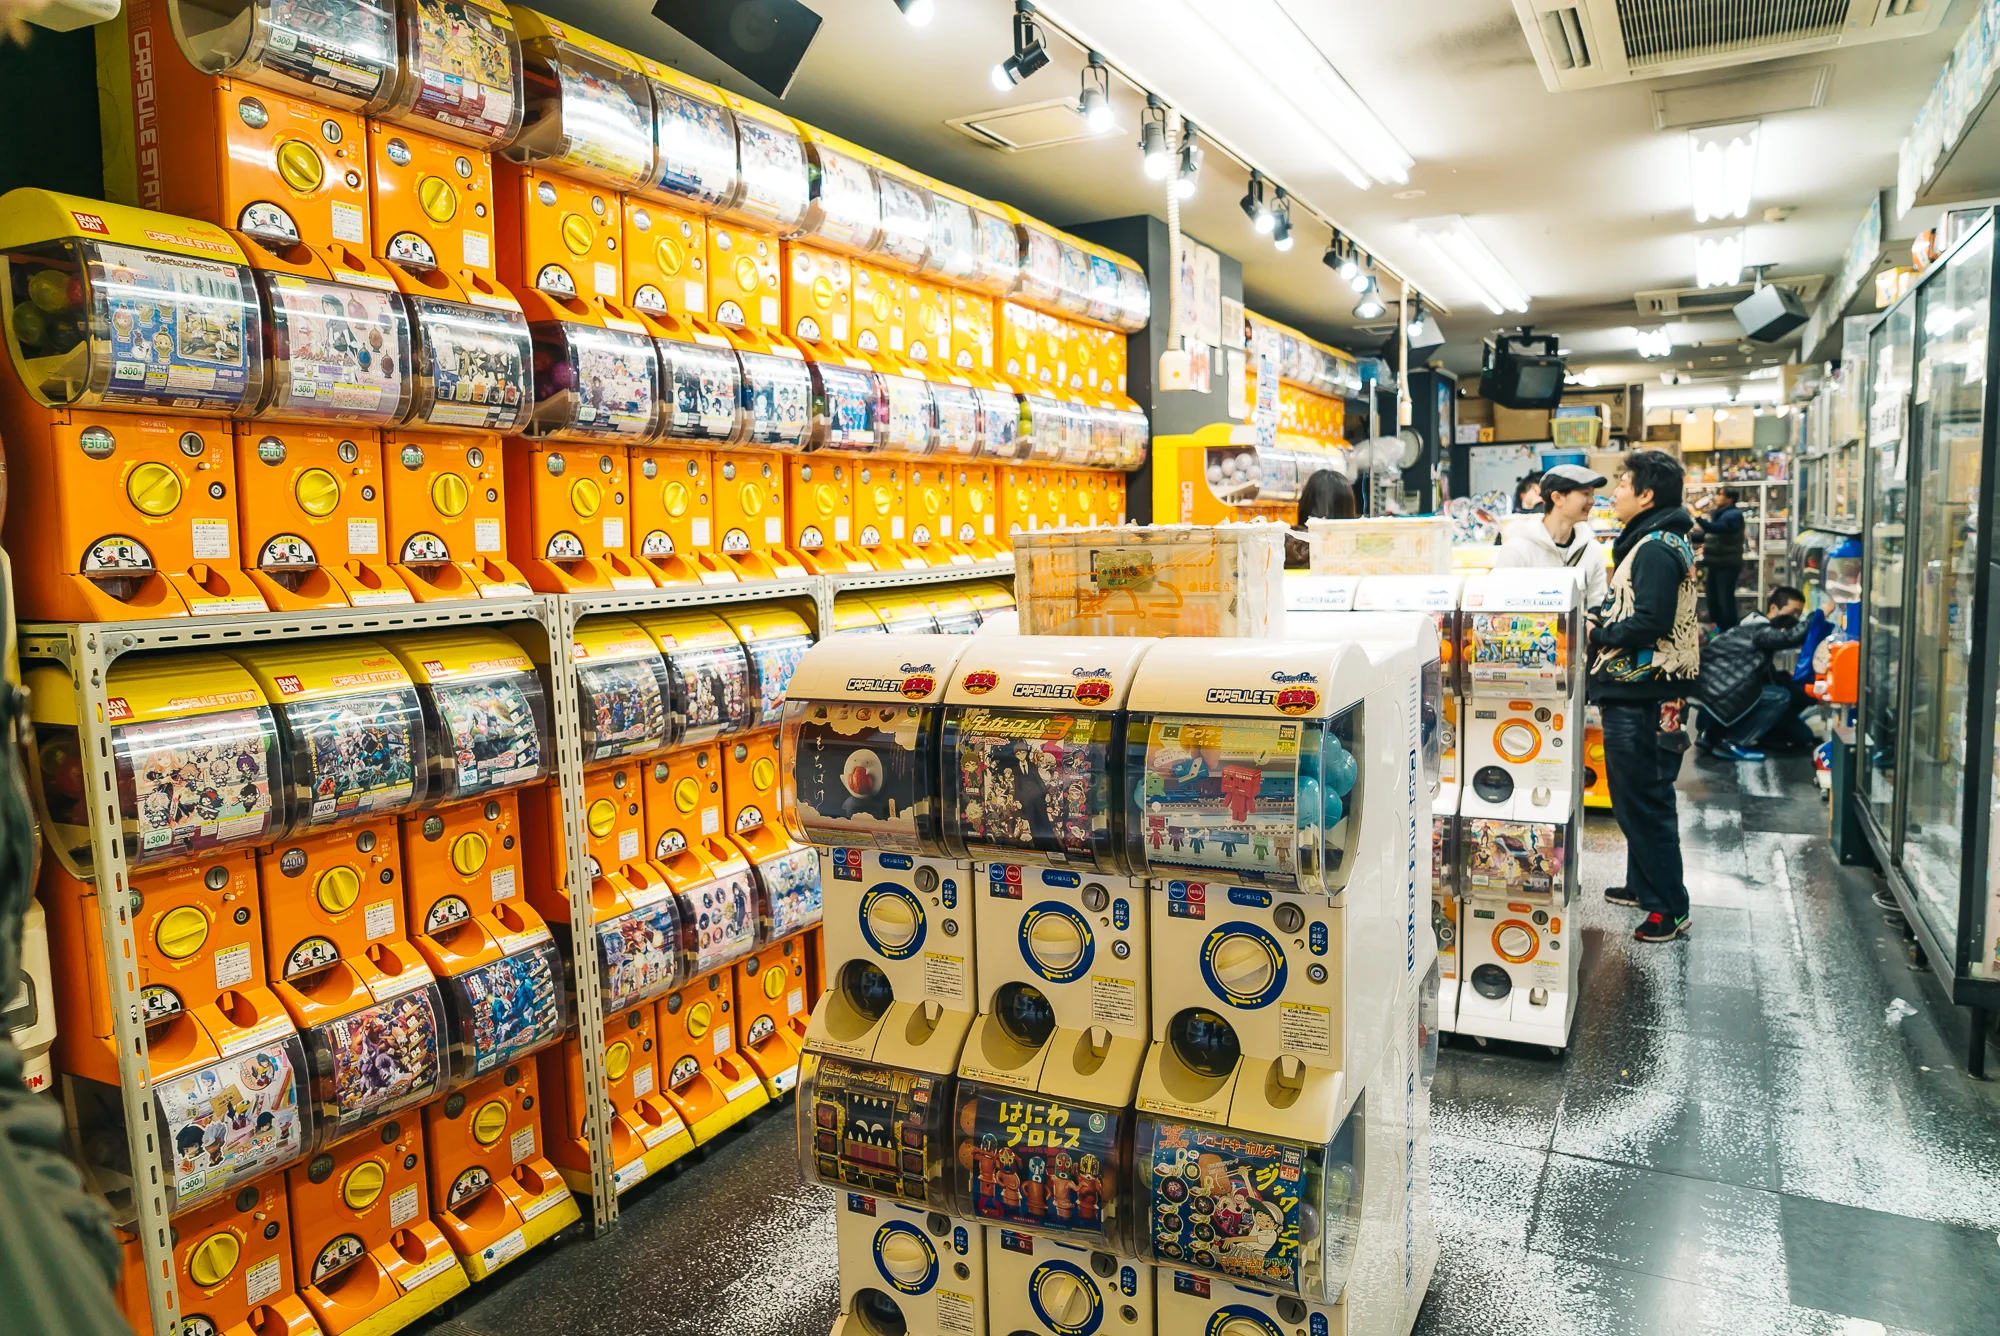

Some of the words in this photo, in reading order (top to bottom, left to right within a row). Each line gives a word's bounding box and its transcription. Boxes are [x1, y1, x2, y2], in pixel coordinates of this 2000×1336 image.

[134, 31, 157, 146] CAPSULE
[76, 213, 103, 225] BAN
[80, 221, 101, 231] DAI
[146, 231, 194, 247] CAPSULE
[195, 239, 237, 255] STATION
[425, 662, 441, 671] BAN
[470, 660, 499, 672] CAPSULE
[499, 656, 528, 668] STATION
[278, 677, 298, 687] BAN
[332, 674, 370, 688] CAPSULE
[370, 670, 403, 683] STATION
[846, 678, 890, 691] CAPSULE
[283, 685, 299, 694] DAI
[1013, 684, 1062, 698] CAPSULE
[1206, 688, 1262, 703] CAPSULE
[108, 700, 126, 709] AN
[170, 695, 216, 711] CAPSULE
[217, 689, 258, 705] STATION
[1232, 892, 1261, 901] コイン投入口
[1000, 1101, 1070, 1126] はにわ
[1006, 1124, 1081, 1148] プロレス
[1197, 1133, 1281, 1157] レコードキーホルダー
